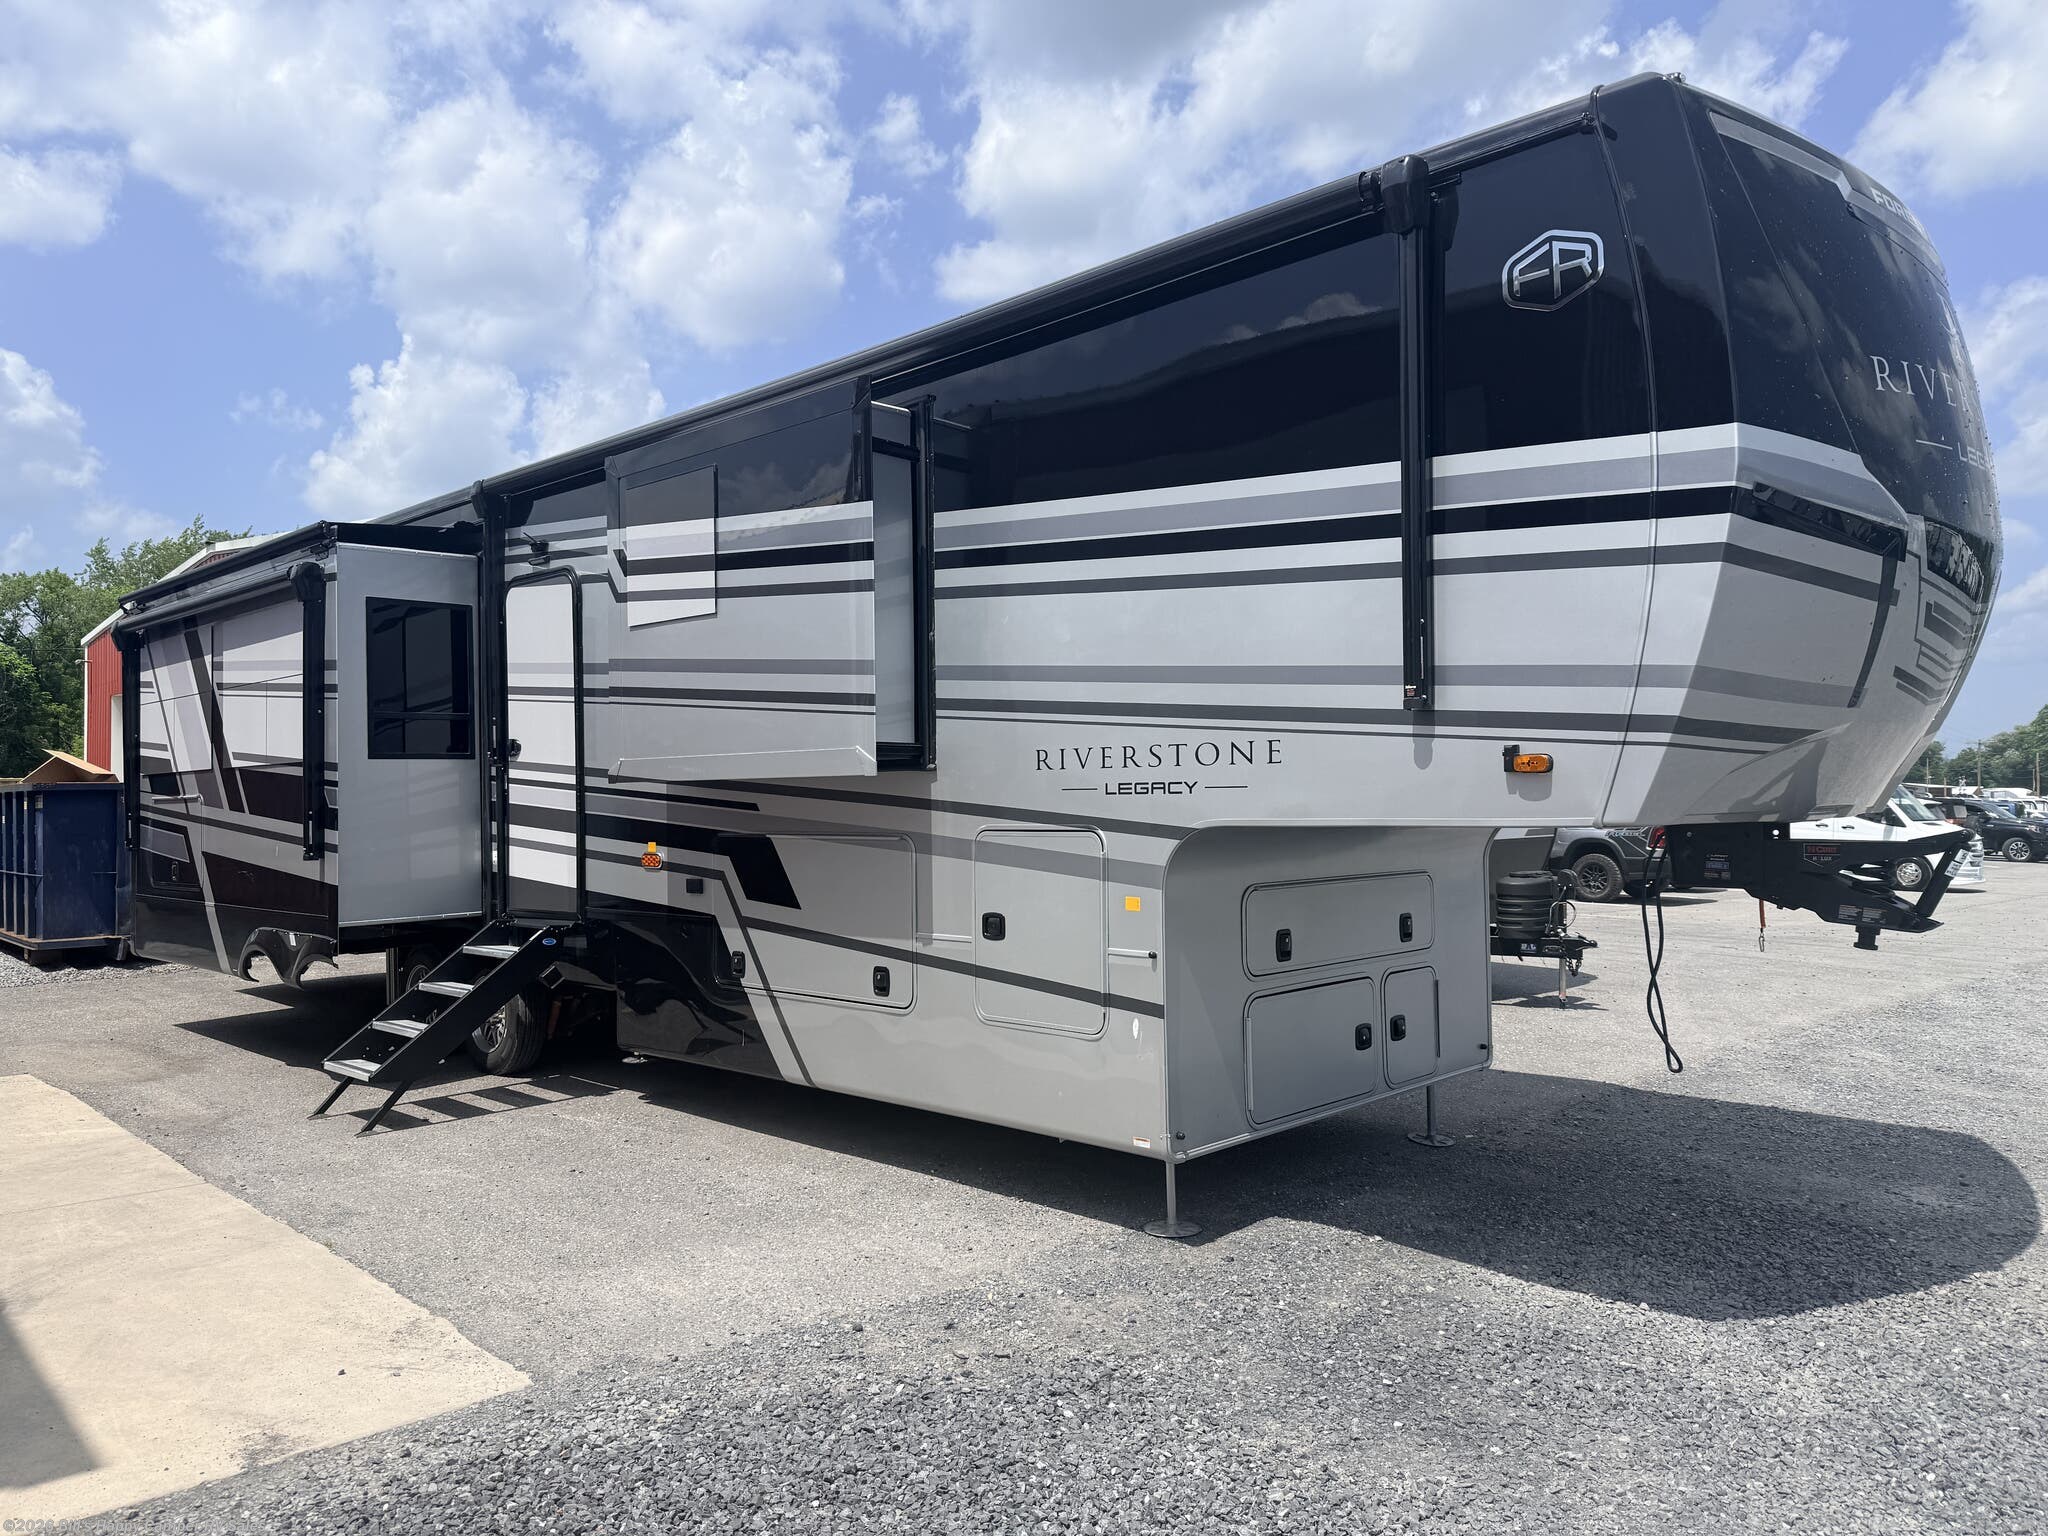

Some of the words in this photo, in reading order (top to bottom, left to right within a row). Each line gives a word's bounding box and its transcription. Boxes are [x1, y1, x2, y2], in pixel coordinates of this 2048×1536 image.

[1512, 240, 1593, 300] FR
[1869, 354, 1978, 422] RIVER
[1957, 441, 1990, 470] LEG
[1035, 739, 1283, 771] RIVERSTONE
[1104, 781, 1199, 795] LEGACY
